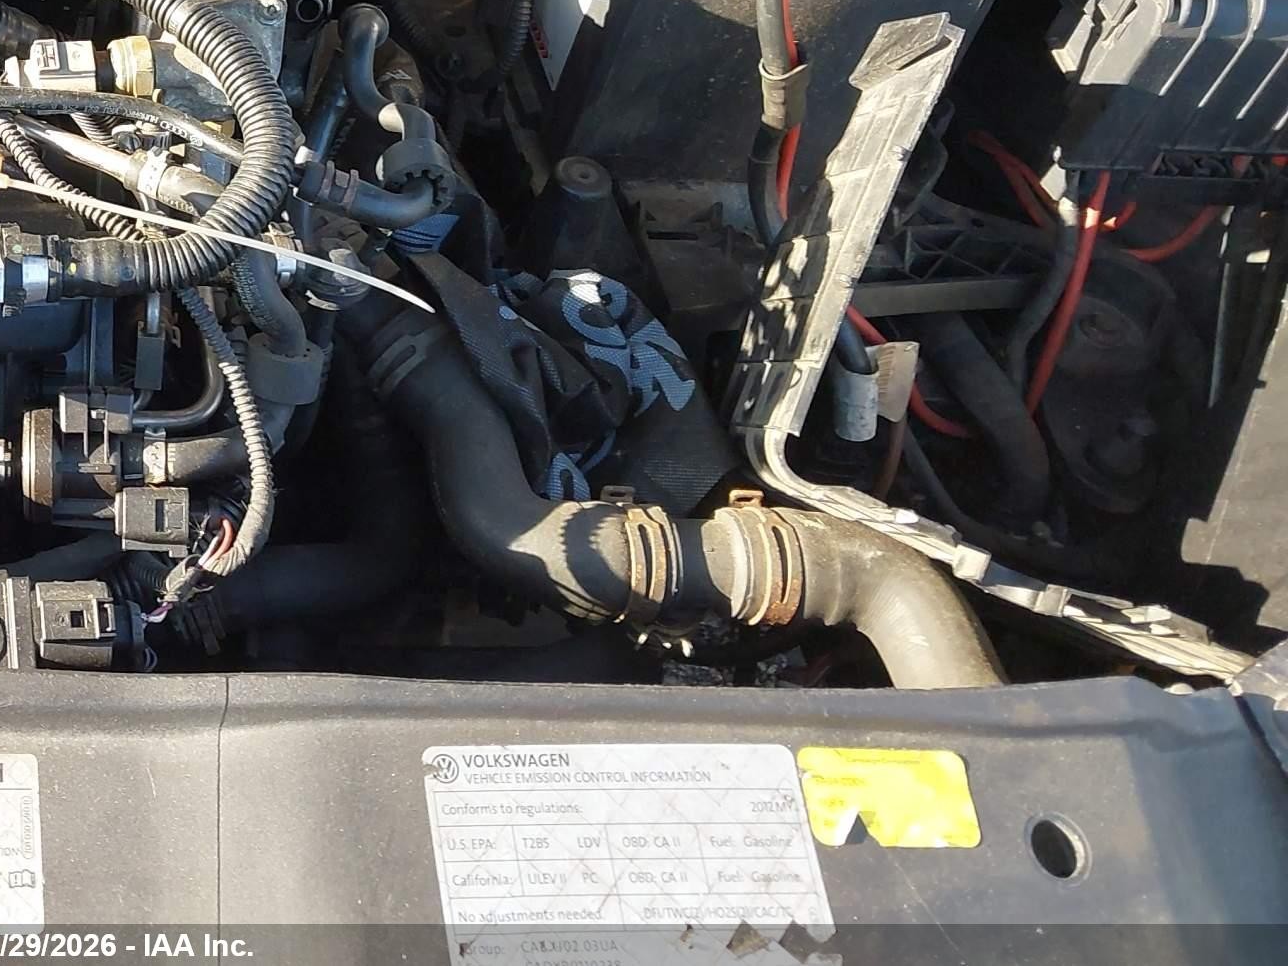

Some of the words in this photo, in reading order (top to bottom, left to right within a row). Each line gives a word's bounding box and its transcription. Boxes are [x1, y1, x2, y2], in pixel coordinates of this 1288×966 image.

[462, 753, 570, 768] VOLKSWAGEN
[465, 772, 512, 784] VEHICLE
[517, 771, 572, 784] EMISSION
[574, 771, 629, 783] CONTROL
[631, 771, 712, 783] INFORMATION
[441, 803, 498, 815] Conforms
[500, 803, 512, 815] to
[577, 837, 602, 849] LDV
[654, 836, 672, 848] CA
[743, 835, 794, 848] Gasoline
[452, 873, 514, 887] California:
[583, 872, 601, 884] PC
[661, 871, 677, 883] CA
[751, 871, 803, 883] Gasoline
[458, 911, 475, 923] No
[479, 910, 555, 926] adjustments
